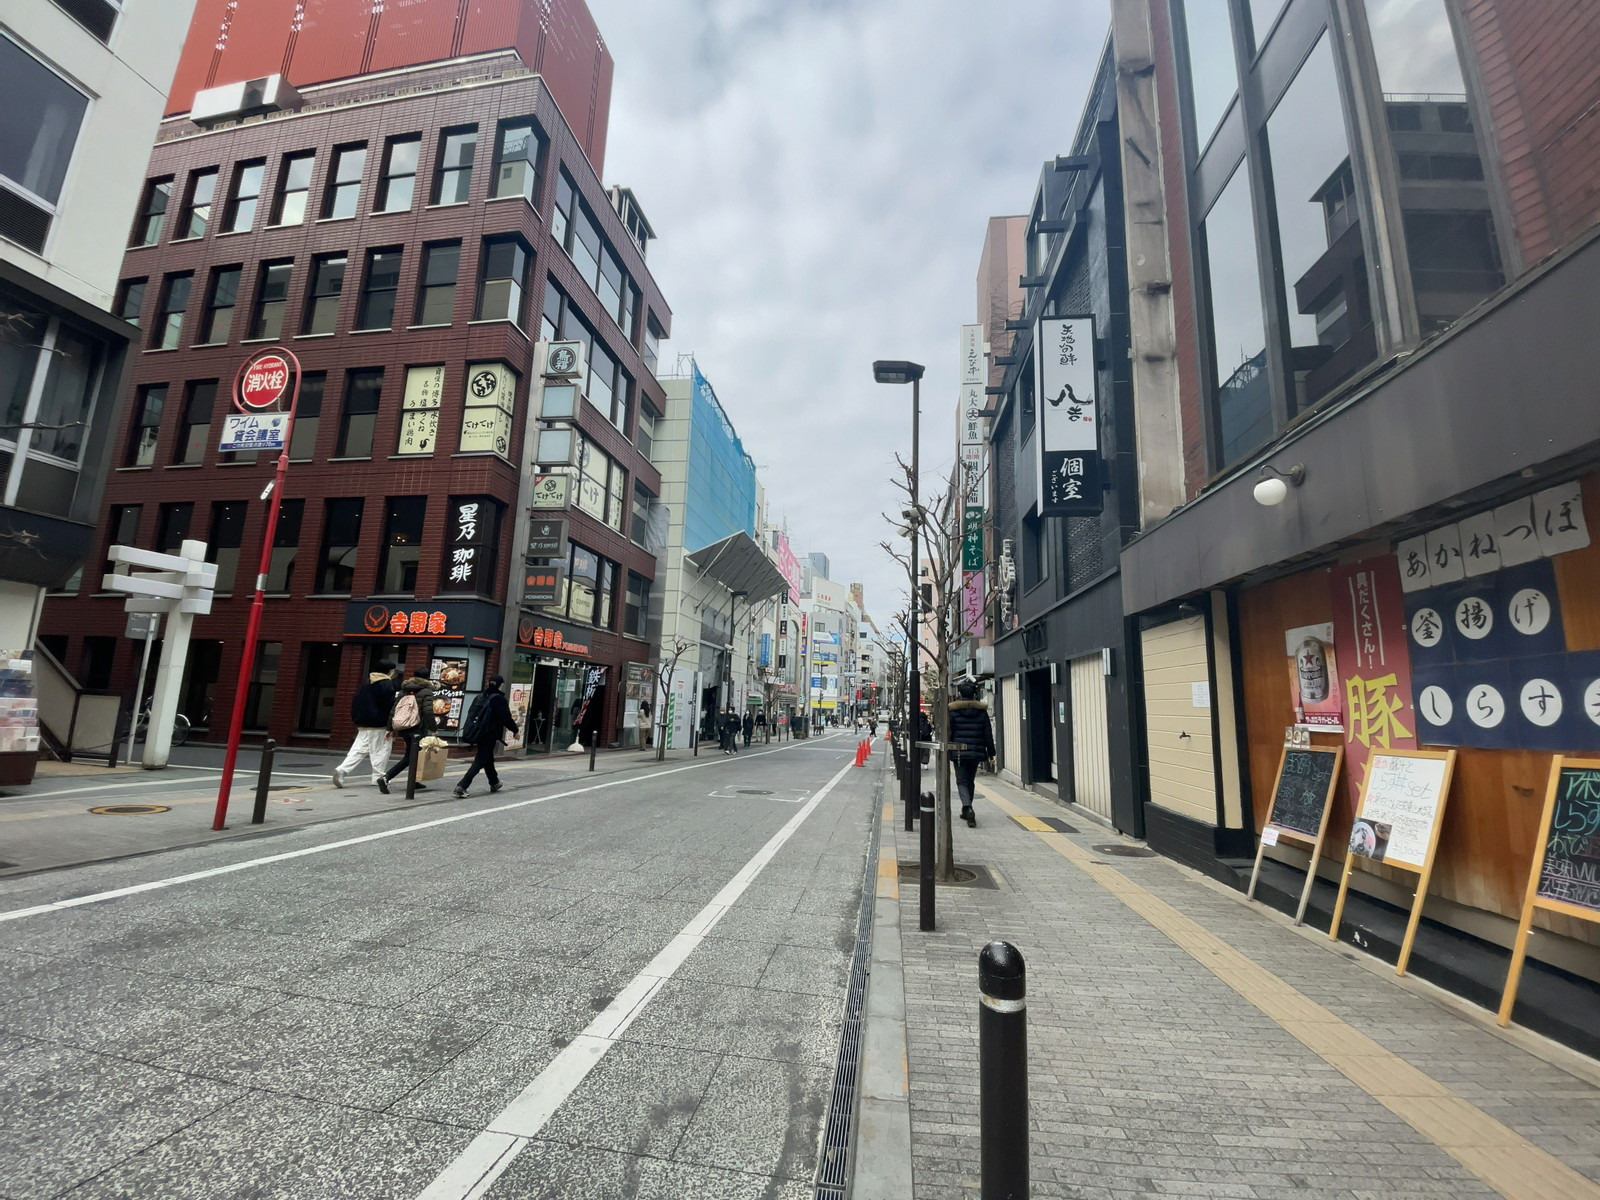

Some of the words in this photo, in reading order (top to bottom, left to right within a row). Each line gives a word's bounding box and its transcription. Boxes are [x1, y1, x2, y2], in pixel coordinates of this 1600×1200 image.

[246, 370, 284, 393] 消火栓
[230, 416, 259, 430] ワイム
[465, 420, 494, 429] てけてけ
[233, 428, 281, 442] 貸会議室
[1060, 457, 1084, 501] 個室
[535, 491, 564, 500] てけてけ
[449, 503, 479, 583] 星乃珈琲
[1407, 494, 1581, 579] あかねつぼ
[390, 611, 447, 634] 吉野家
[1414, 593, 1541, 640] 釜揚げ
[533, 626, 563, 650] 吉野家
[1345, 673, 1414, 750] 豚
